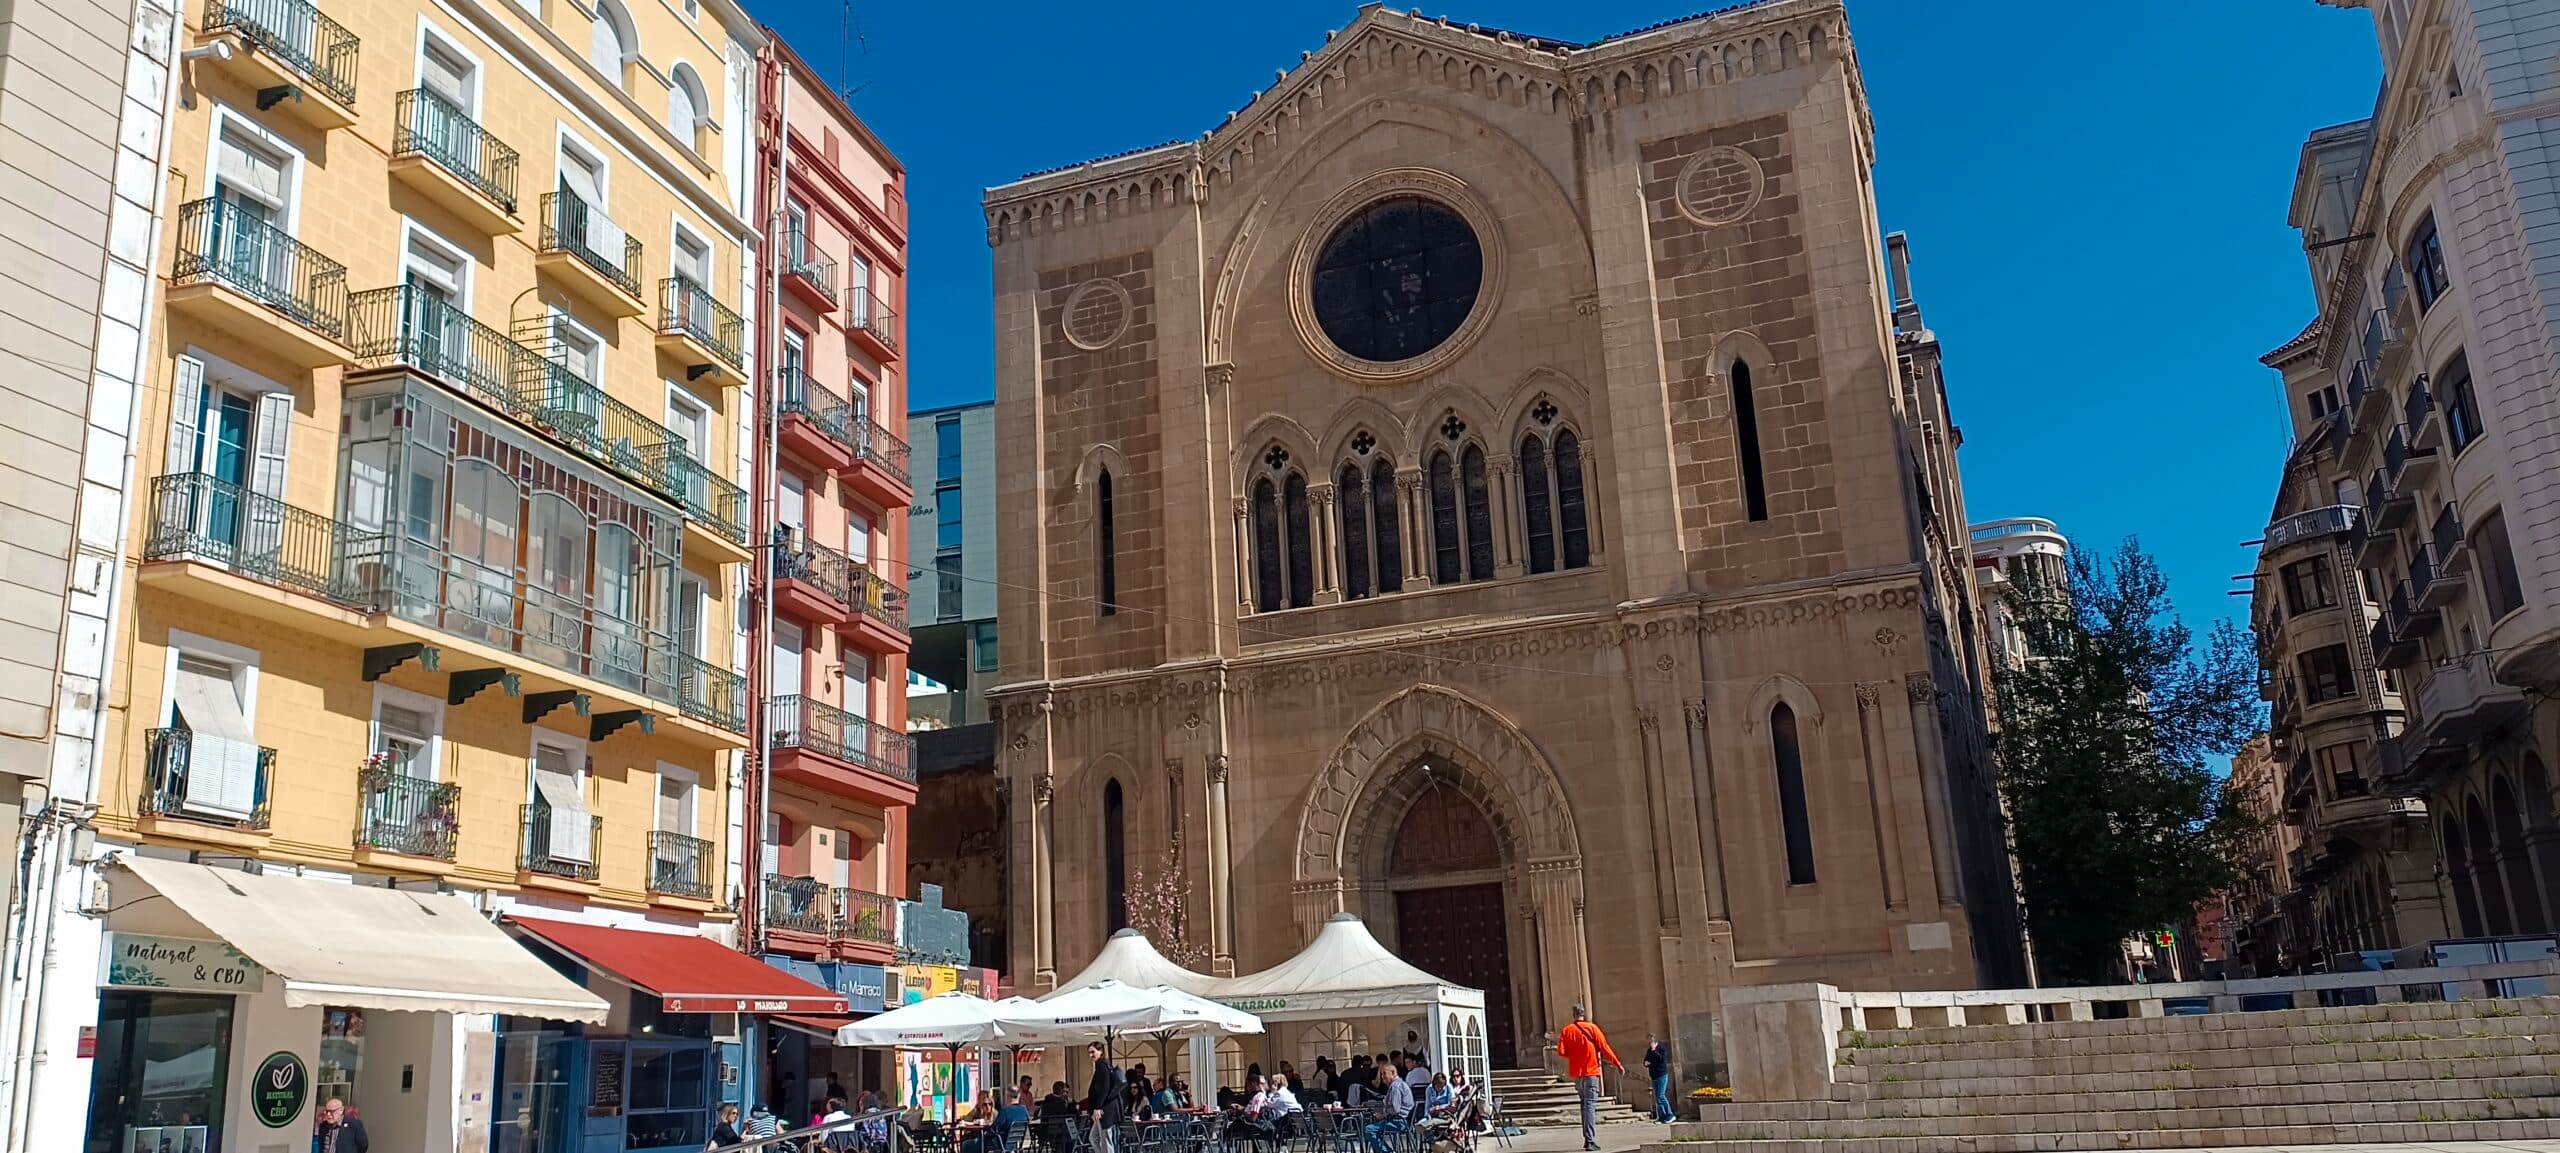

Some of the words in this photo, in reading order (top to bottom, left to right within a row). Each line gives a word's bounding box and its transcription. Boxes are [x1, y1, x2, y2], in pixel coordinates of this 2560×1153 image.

[194, 965, 206, 981] &
[214, 968, 245, 985] CBD
[837, 979, 847, 994] Lo
[849, 979, 882, 997] Marraco
[1231, 999, 1286, 1011] MARRACO
[270, 1107, 287, 1117] CBD
